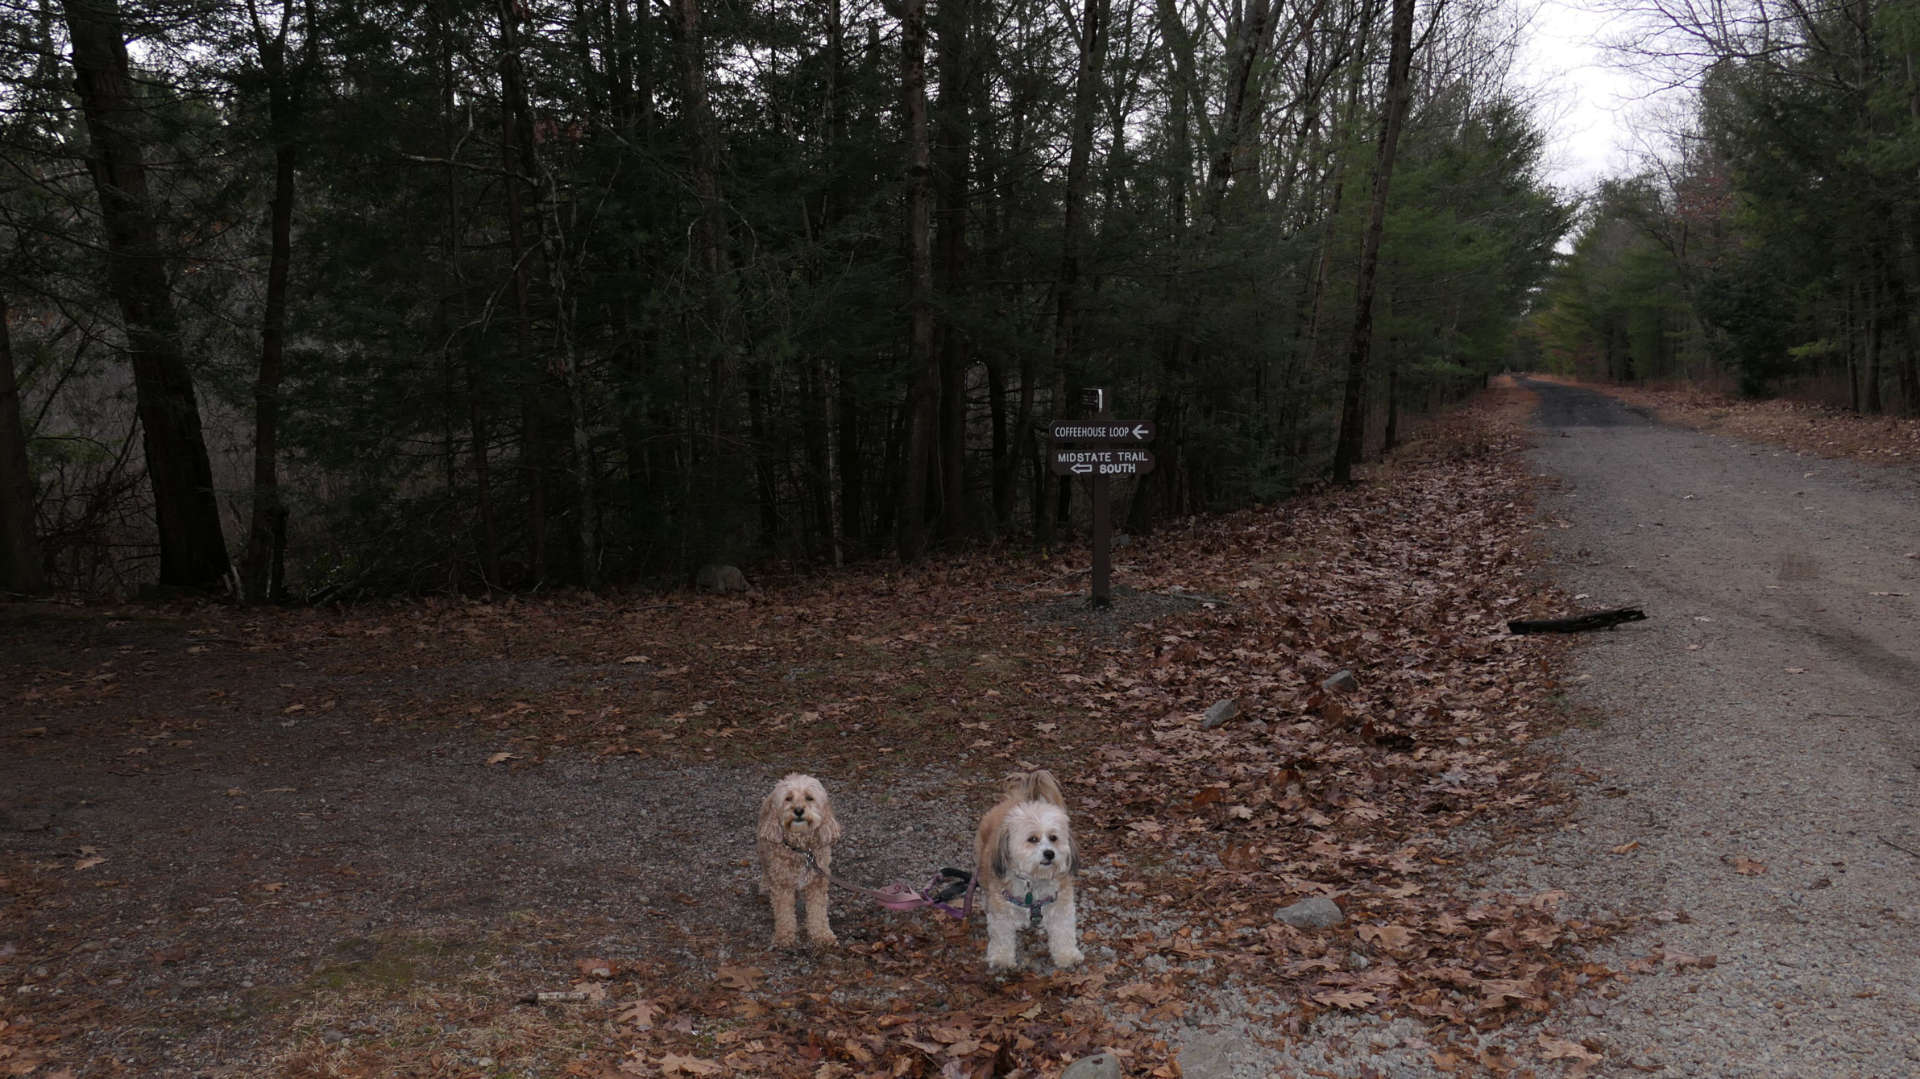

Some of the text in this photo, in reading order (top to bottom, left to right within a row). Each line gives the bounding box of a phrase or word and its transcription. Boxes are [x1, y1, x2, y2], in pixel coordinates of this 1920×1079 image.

[1055, 427, 1129, 437] COFFEEHOUSE LOOP
[1058, 452, 1149, 462] MIDSTATE TRAIL
[1099, 463, 1136, 473] SOUTH
